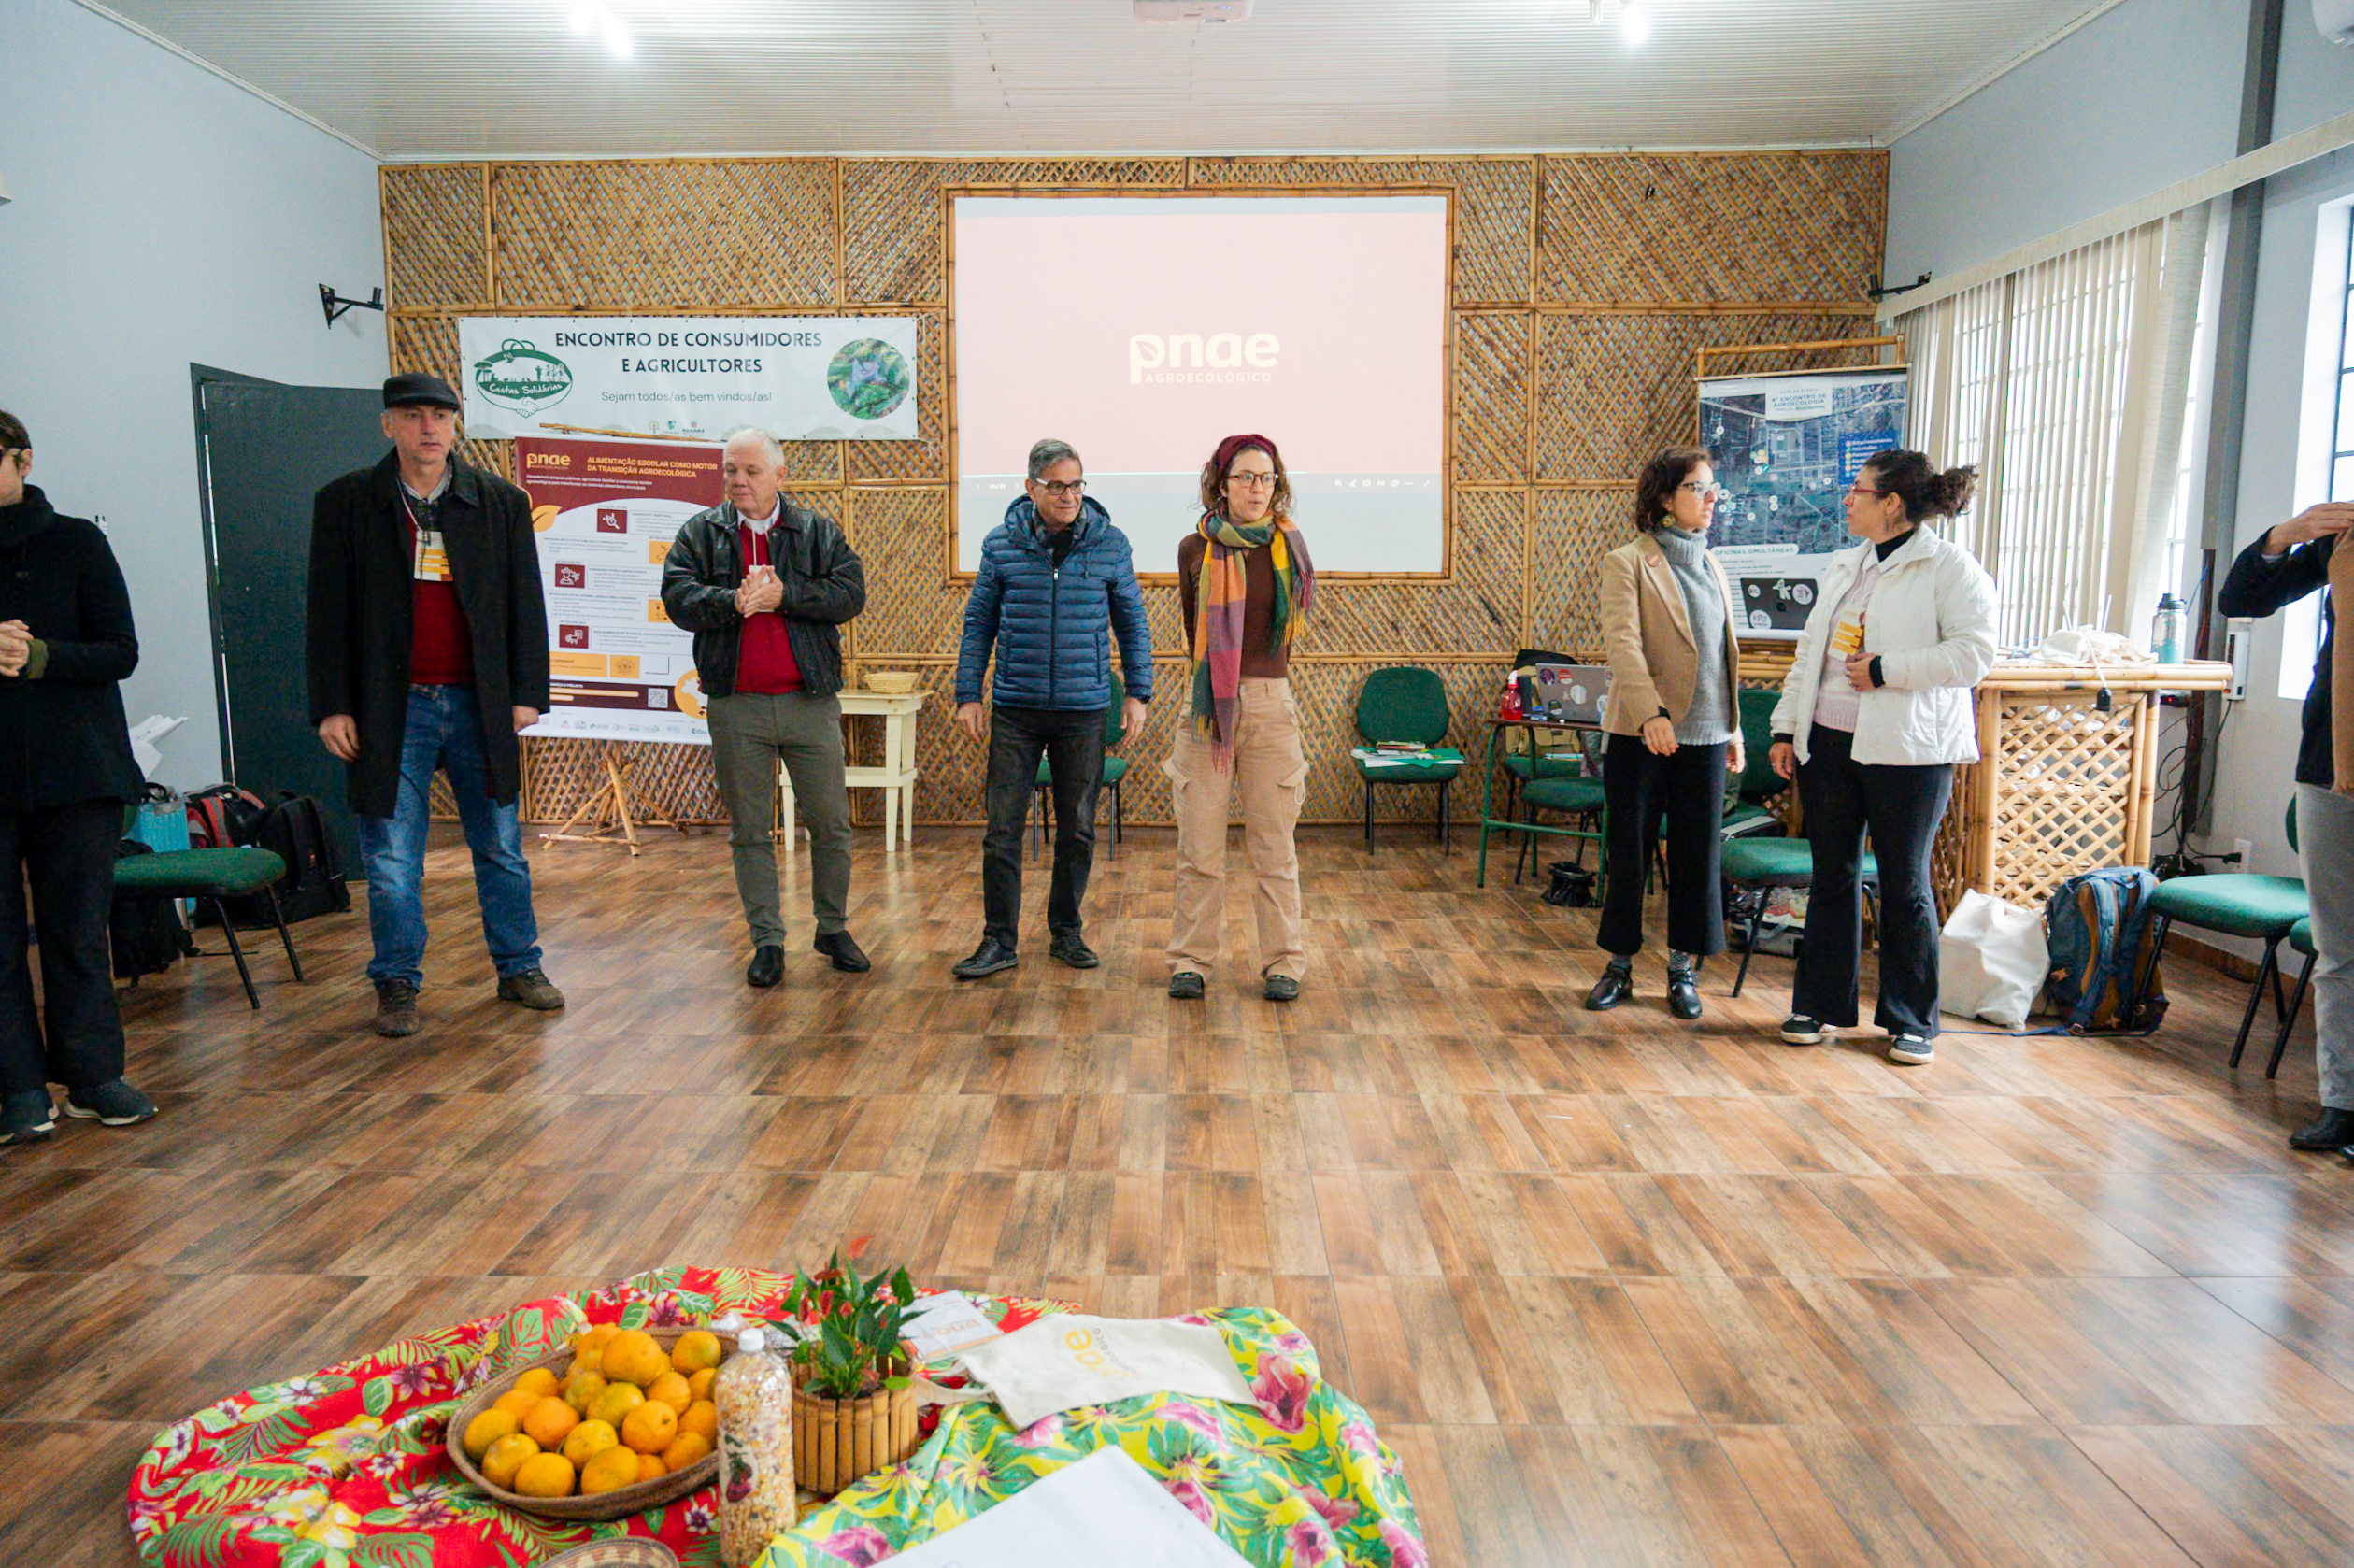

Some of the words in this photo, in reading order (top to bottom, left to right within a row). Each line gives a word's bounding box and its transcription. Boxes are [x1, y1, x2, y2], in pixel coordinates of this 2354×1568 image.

[555, 332, 652, 347] ENCONTRO
[658, 332, 679, 347] DE
[684, 332, 822, 347] CONSUMIDORES
[622, 359, 630, 373] E
[635, 358, 763, 373] AGRICULTORES
[1129, 332, 1281, 385] pnae
[1145, 370, 1272, 383] AGROECOLÓGICO
[489, 383, 520, 394] Cestas
[521, 383, 563, 394] Solidárias
[601, 391, 635, 403] Sejam
[638, 391, 687, 403] todos/as
[690, 392, 715, 402] bem
[717, 391, 772, 403] vindos/as!
[1780, 393, 1816, 402] ENCONTRO
[526, 452, 571, 469] pnae
[587, 456, 636, 467] ALIMENTAÇÃO
[637, 459, 668, 468] ESCOLAR
[670, 461, 692, 469] COMO
[692, 462, 718, 471] MOTOR
[598, 465, 637, 475] TRANSIÇÃO
[638, 467, 697, 478] AGROECOLÓGICA
